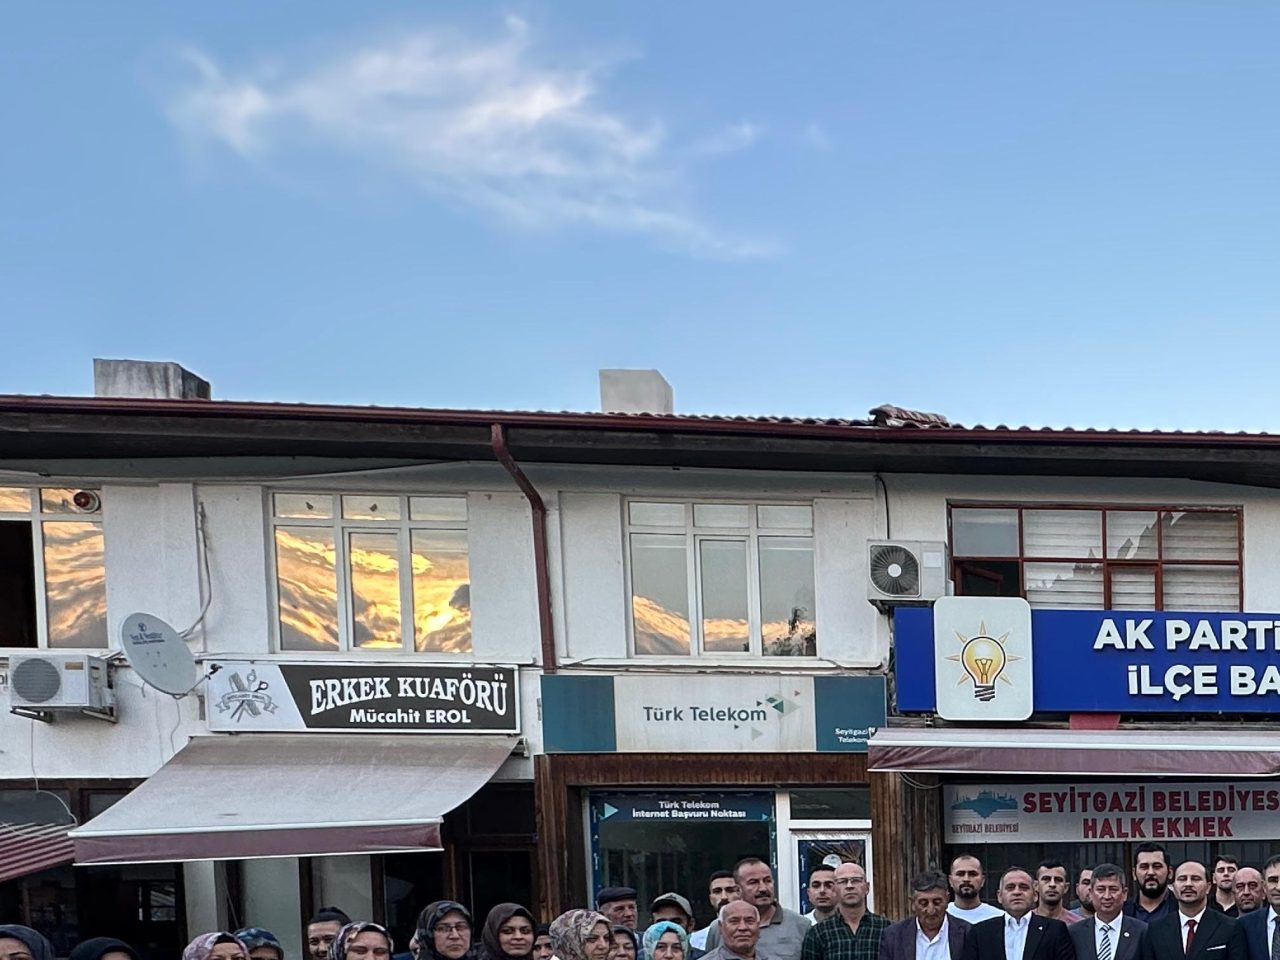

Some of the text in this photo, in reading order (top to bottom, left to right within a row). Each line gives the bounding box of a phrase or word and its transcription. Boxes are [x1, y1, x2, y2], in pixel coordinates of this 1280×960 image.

[1093, 618, 1155, 650] AK
[309, 672, 507, 716] ERKEK KUAFÖRÜ
[349, 708, 472, 723] Mücahit EROL
[643, 706, 767, 721] Türk Telekom
[658, 801, 720, 809] Türk Telekom
[1022, 785, 1146, 813] SEYİTGAZİ
[632, 808, 746, 819] İnternet Başvuru Noktası
[1083, 816, 1233, 839] HALK EKMEK
